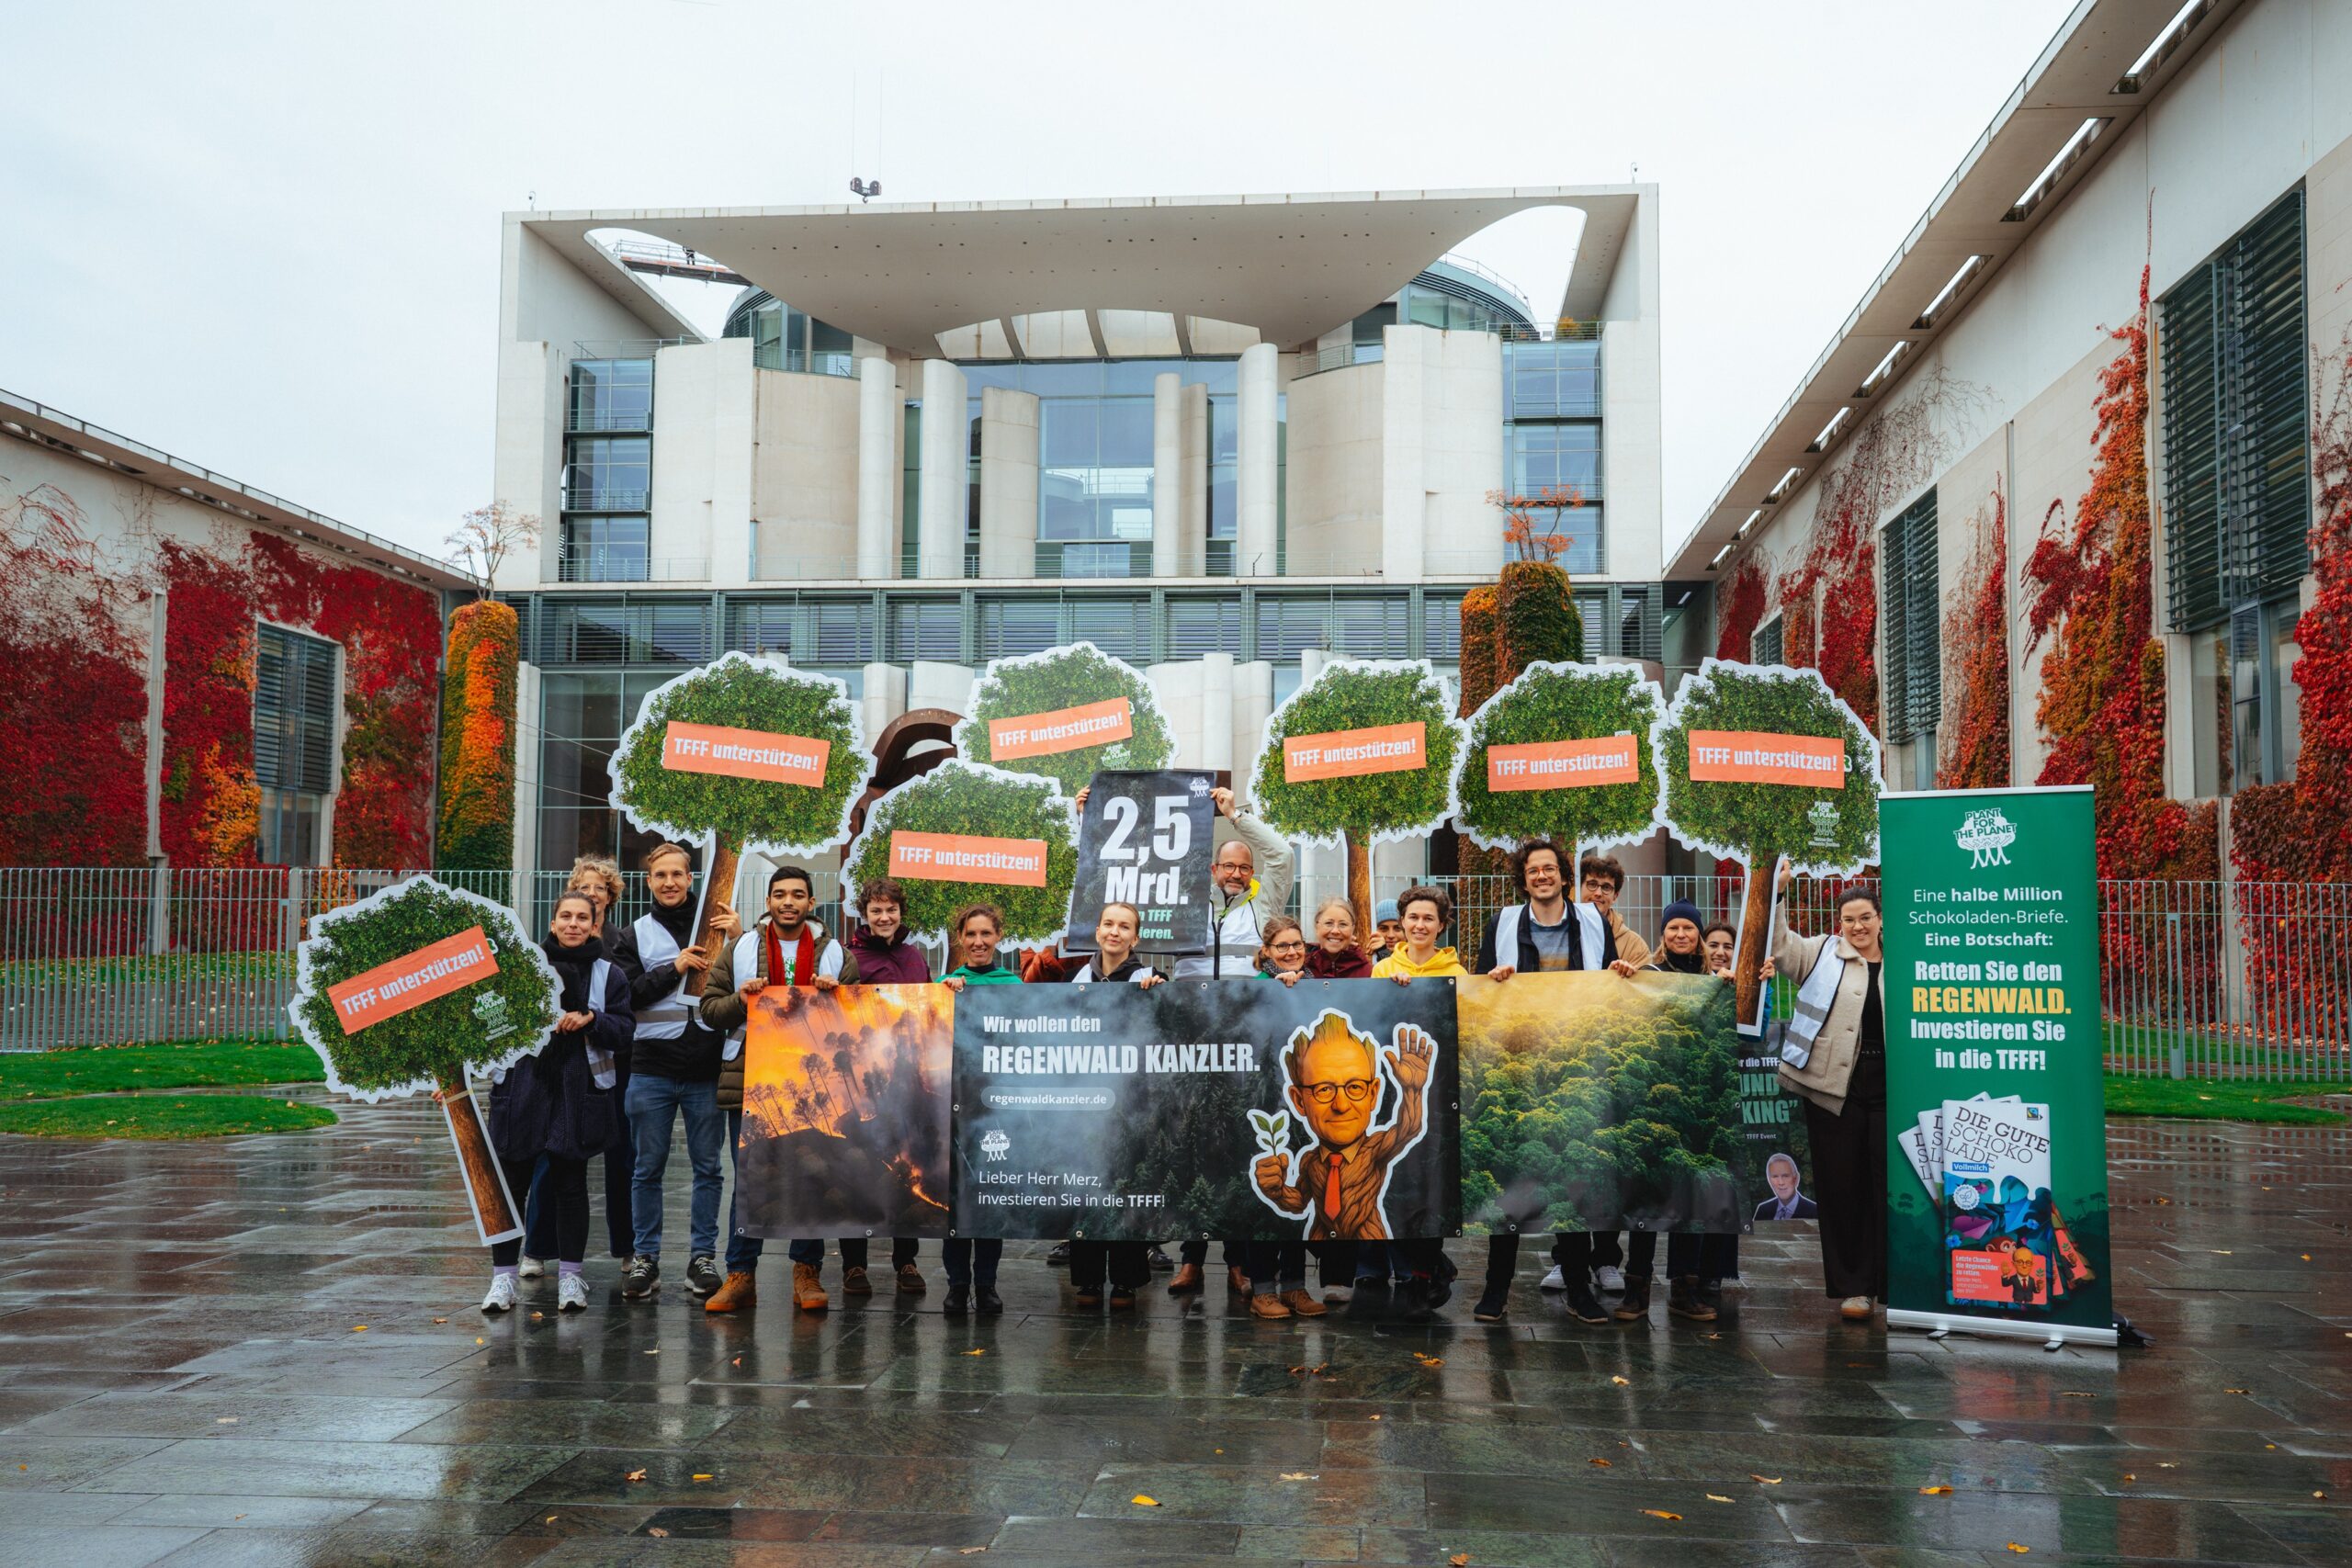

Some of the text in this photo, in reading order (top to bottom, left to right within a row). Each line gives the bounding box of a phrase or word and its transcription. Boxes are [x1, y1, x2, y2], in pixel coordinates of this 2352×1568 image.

[997, 712, 1124, 747] TFFF unterstützen!
[674, 738, 709, 757] TFFF
[712, 743, 819, 772] unterstützen!
[1291, 738, 1416, 767] TFFF unterstützen!
[1495, 750, 1629, 776] TFFF unterstützen!
[1697, 747, 1731, 765] TFFF
[1734, 750, 1838, 772] unterstützen!
[1965, 807, 2001, 820] PLANT
[1973, 818, 1996, 829] FOR
[1100, 795, 1192, 866] 2,5
[1954, 823, 2017, 840] THE PLANET
[899, 846, 1039, 871] TFFF unterstützen!
[1104, 866, 1189, 905] Mrd.
[1914, 886, 2063, 902] Eine halbe Million
[1148, 908, 1173, 922] TFFF
[1909, 908, 2069, 925] Schokoladen-Briefe.
[1139, 926, 1174, 940] ieren.
[1925, 931, 2053, 946] Eine Botschaft:
[341, 988, 379, 1015] TFFF
[379, 944, 485, 1000] unterstützen!
[1915, 960, 2062, 981] Retten Sie den
[1913, 987, 2072, 1014] REGENWALD.
[983, 1015, 1101, 1032] Wir wollen den
[1910, 1019, 2065, 1042] Investieren Sie
[982, 1043, 1261, 1074] REGENWALD KANZLER.
[1746, 1057, 1759, 1067] die
[1935, 1048, 2046, 1070] in die TFFF!
[1739, 1073, 1781, 1098] UND
[989, 1093, 1107, 1107] regenwaldkanzler.de
[1742, 1100, 1798, 1124] KING”
[1955, 1107, 2050, 1154] DIE GUTE
[1944, 1137, 1998, 1169] LADE
[1951, 1122, 2033, 1163] SCHOKO
[1953, 1163, 1989, 1172] Vollmilch
[978, 1171, 1102, 1188] Lieber Herr Merz,
[978, 1191, 1165, 1208] investieren Sie in die TFFF!
